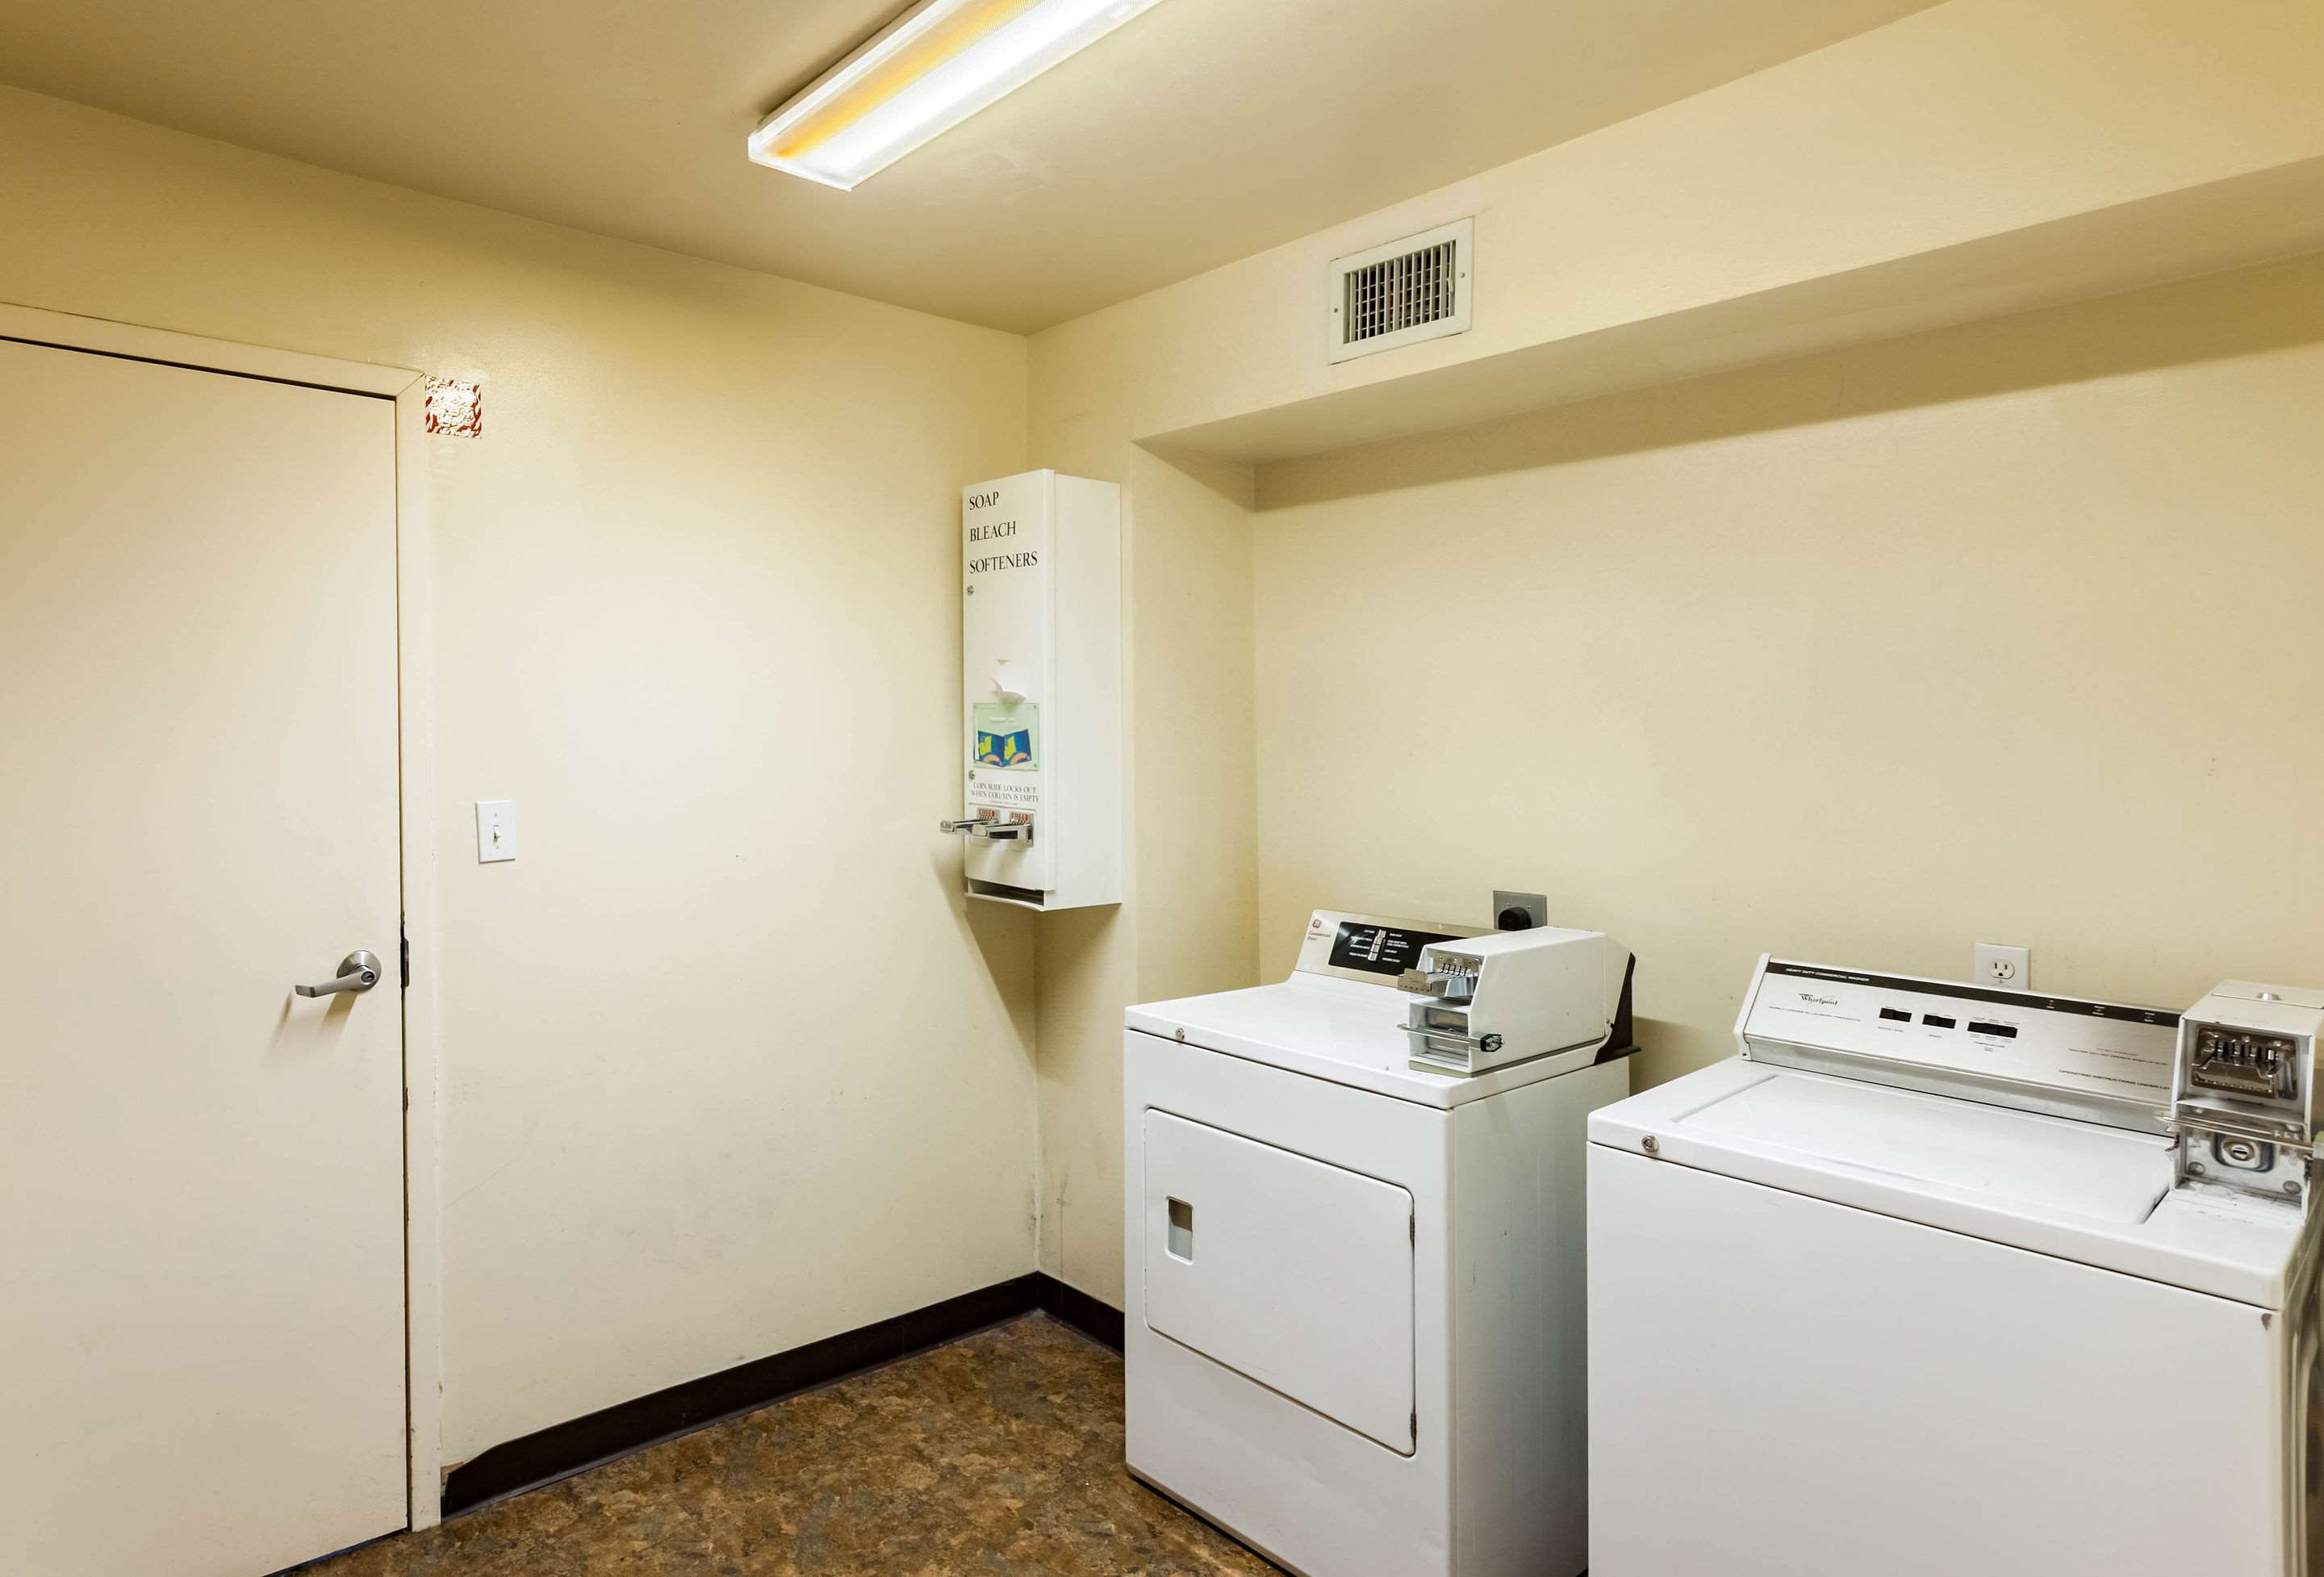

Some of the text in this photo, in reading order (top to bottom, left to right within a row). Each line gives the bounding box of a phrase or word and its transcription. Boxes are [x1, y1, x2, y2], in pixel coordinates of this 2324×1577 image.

[969, 491, 999, 511] SOAP
[970, 521, 1016, 542] BLEACH
[969, 550, 1038, 574] SOFTENERS
[1020, 793, 1039, 802] EMPTY
[1800, 995, 1837, 1006] Whirlpool
